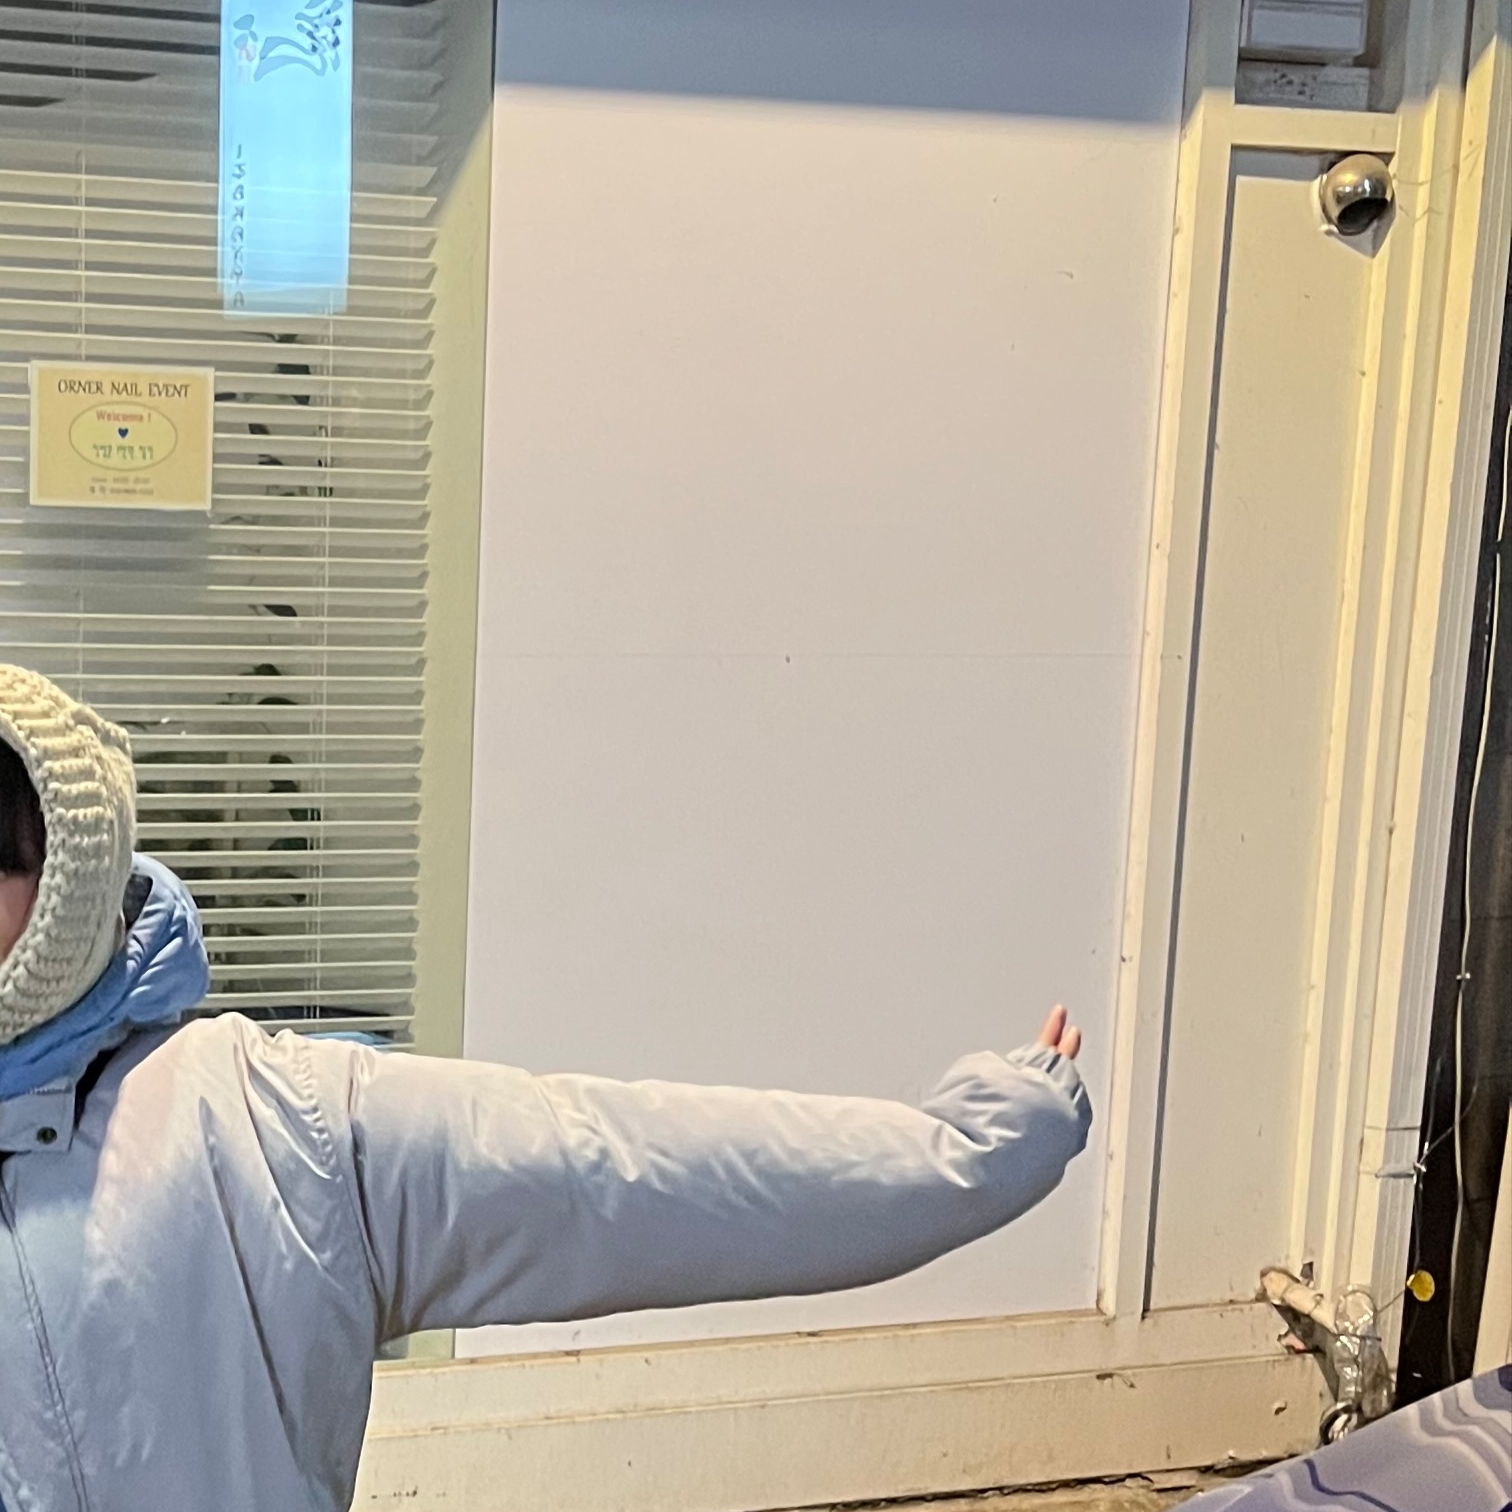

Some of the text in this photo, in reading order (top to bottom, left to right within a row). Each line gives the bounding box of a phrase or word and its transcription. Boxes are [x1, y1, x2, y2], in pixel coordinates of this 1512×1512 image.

[57, 378, 191, 399] ORNER NAIL EVENT
